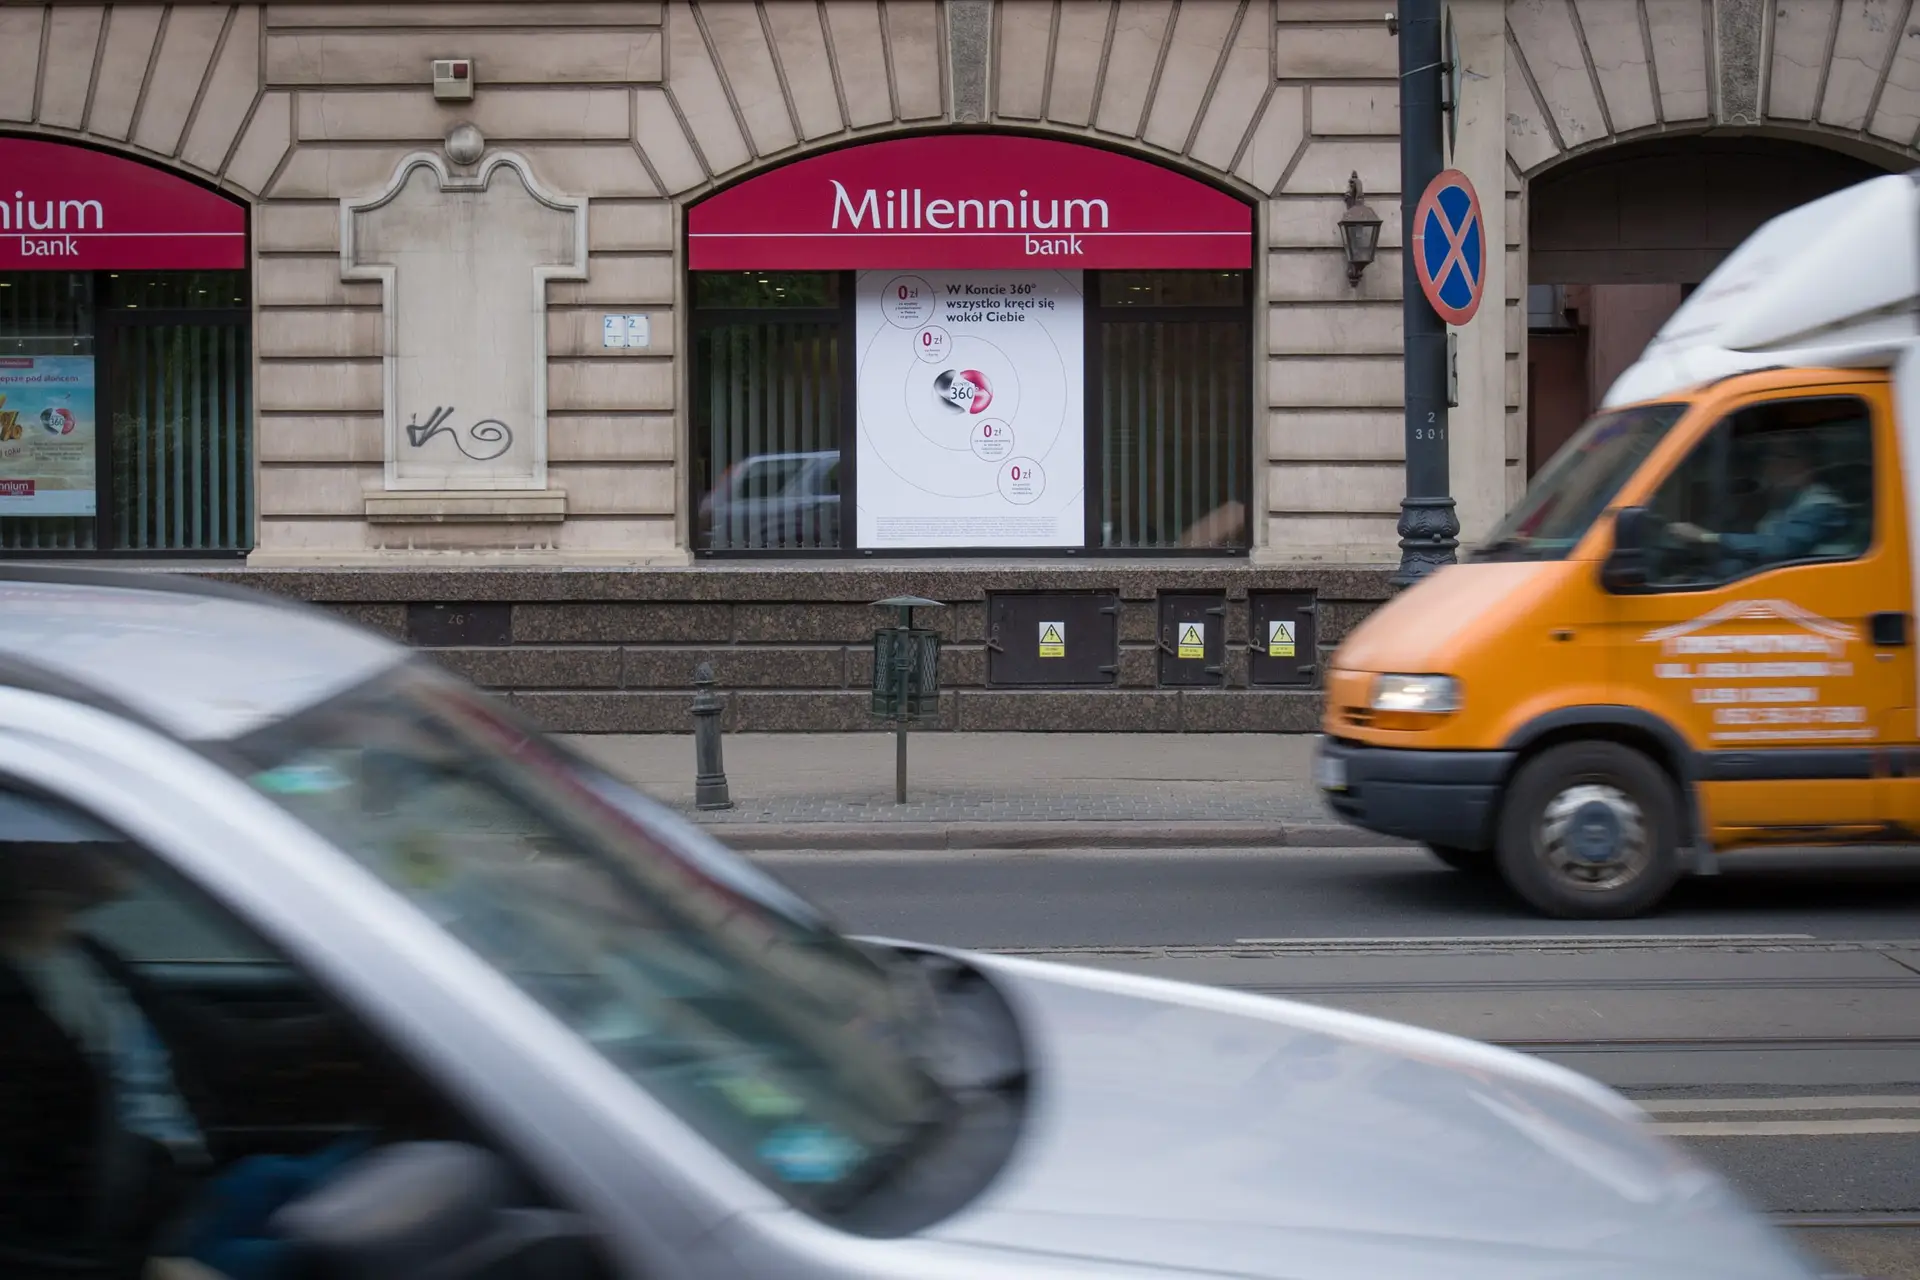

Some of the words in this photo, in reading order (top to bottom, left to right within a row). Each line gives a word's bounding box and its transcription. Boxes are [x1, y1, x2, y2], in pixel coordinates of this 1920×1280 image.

[829, 179, 1109, 229] Millennium
[21, 234, 79, 256] bank
[1025, 234, 1084, 255] bank
[898, 285, 908, 300] 0
[909, 287, 918, 299] zł
[946, 284, 961, 295] W
[965, 284, 1006, 295] Koncie
[946, 298, 1000, 311] wszystko
[1004, 298, 1035, 310] kręci
[1038, 298, 1055, 310] się
[946, 312, 982, 322] wokół
[986, 312, 1025, 322] Ciebie
[922, 332, 932, 346] 0
[934, 335, 943, 344] zł
[1428, 411, 1435, 423] 2
[983, 424, 993, 438] 0
[994, 428, 1002, 436] zł
[1011, 466, 1021, 480] 0
[1023, 469, 1032, 479] zł
